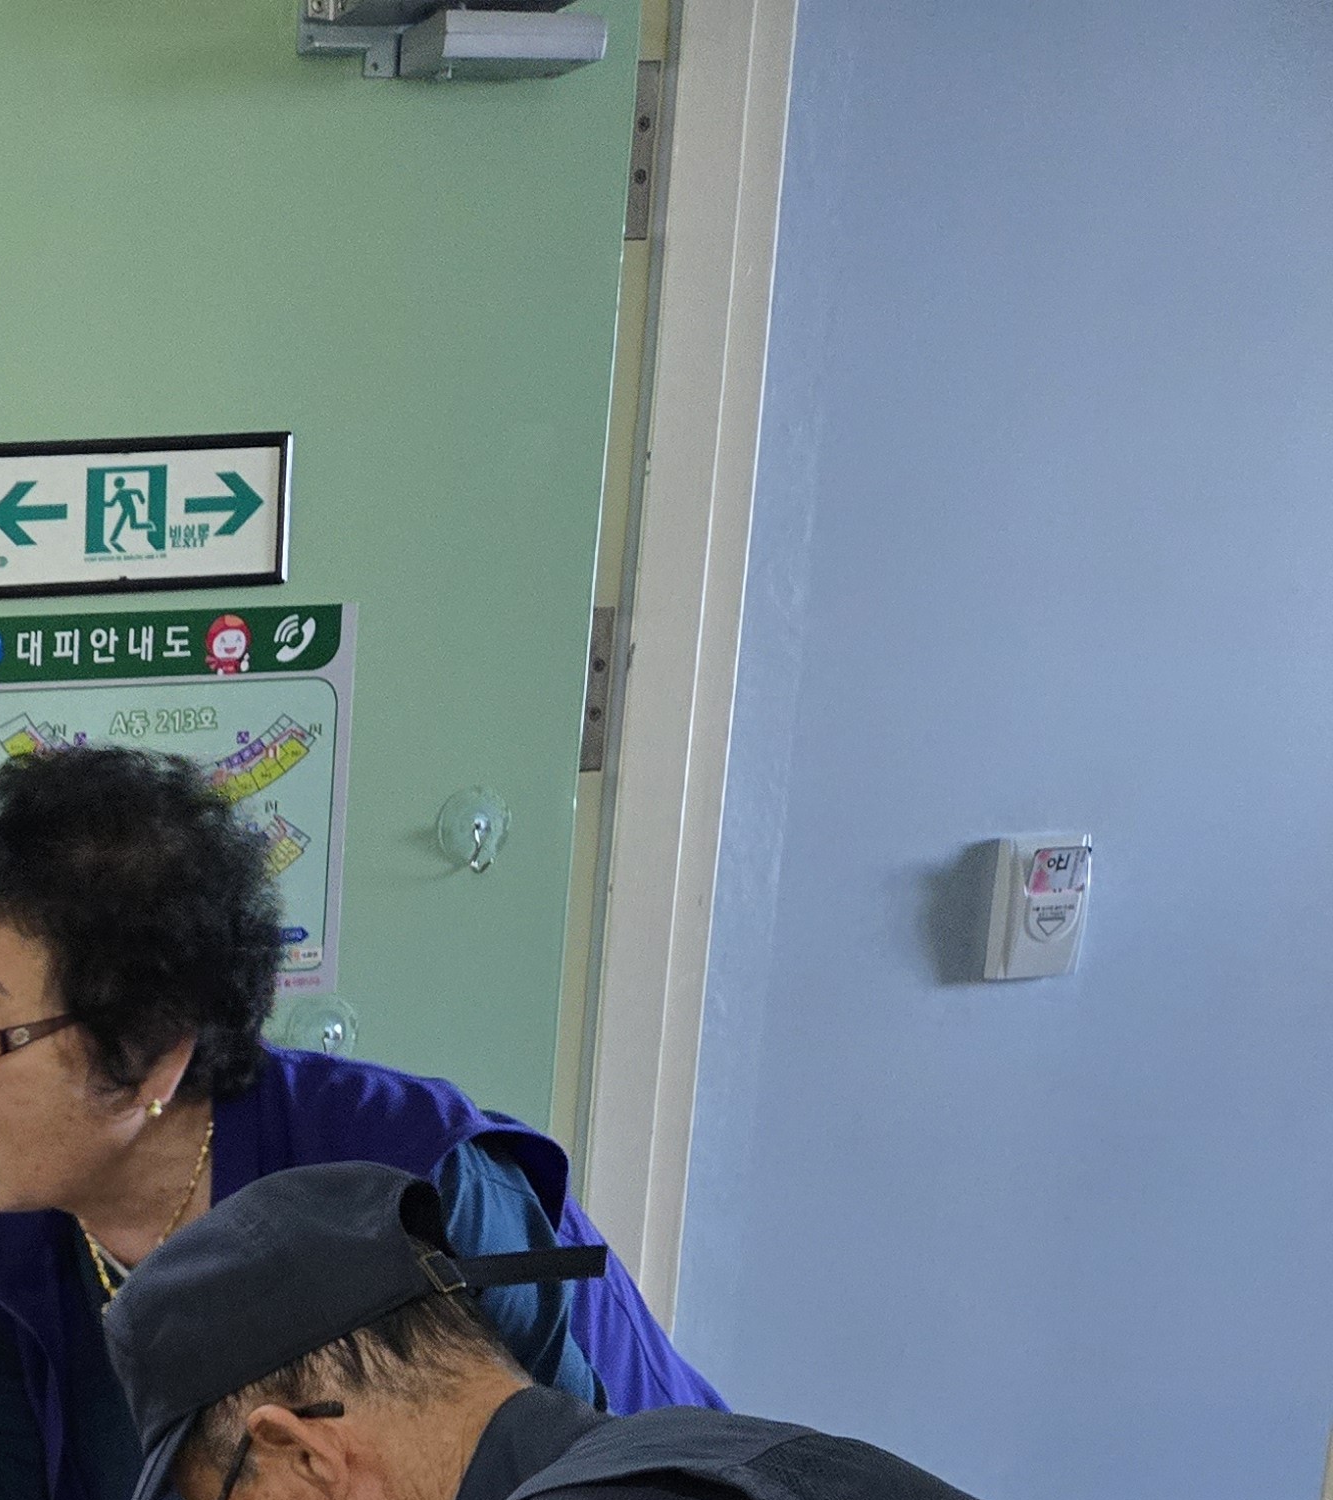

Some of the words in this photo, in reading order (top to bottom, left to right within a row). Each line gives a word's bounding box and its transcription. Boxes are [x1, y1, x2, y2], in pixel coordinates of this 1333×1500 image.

[171, 536, 205, 548] EXIT
[16, 624, 192, 667] 대피안내도
[109, 709, 150, 737] A동
[154, 706, 218, 735] 213호
